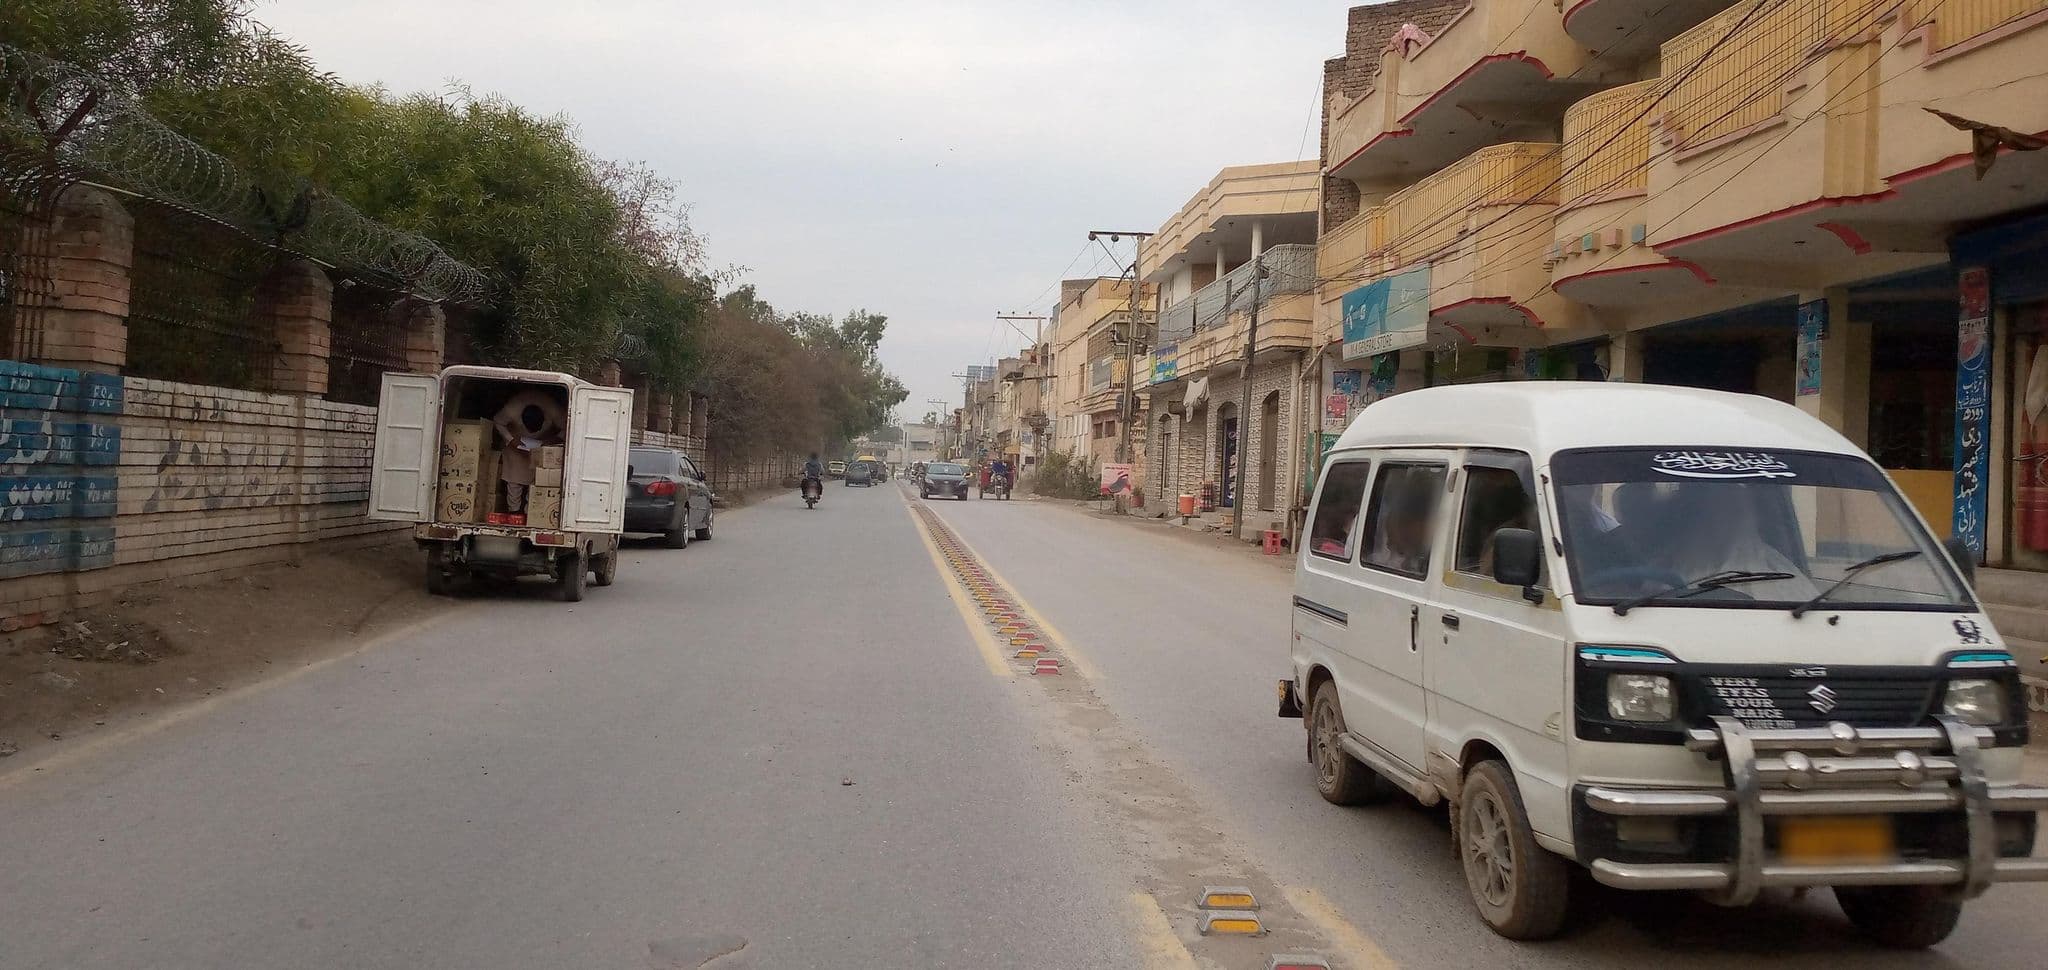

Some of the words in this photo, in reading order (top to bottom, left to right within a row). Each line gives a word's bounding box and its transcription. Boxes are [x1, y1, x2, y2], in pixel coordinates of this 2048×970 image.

[1359, 337, 1377, 354] GENERAL
[1377, 333, 1393, 349] STORE
[1710, 676, 1759, 687] VERY
[1715, 687, 1769, 697] EYES
[1722, 697, 1775, 708] YOUR
[1732, 708, 1784, 719] NAICE
